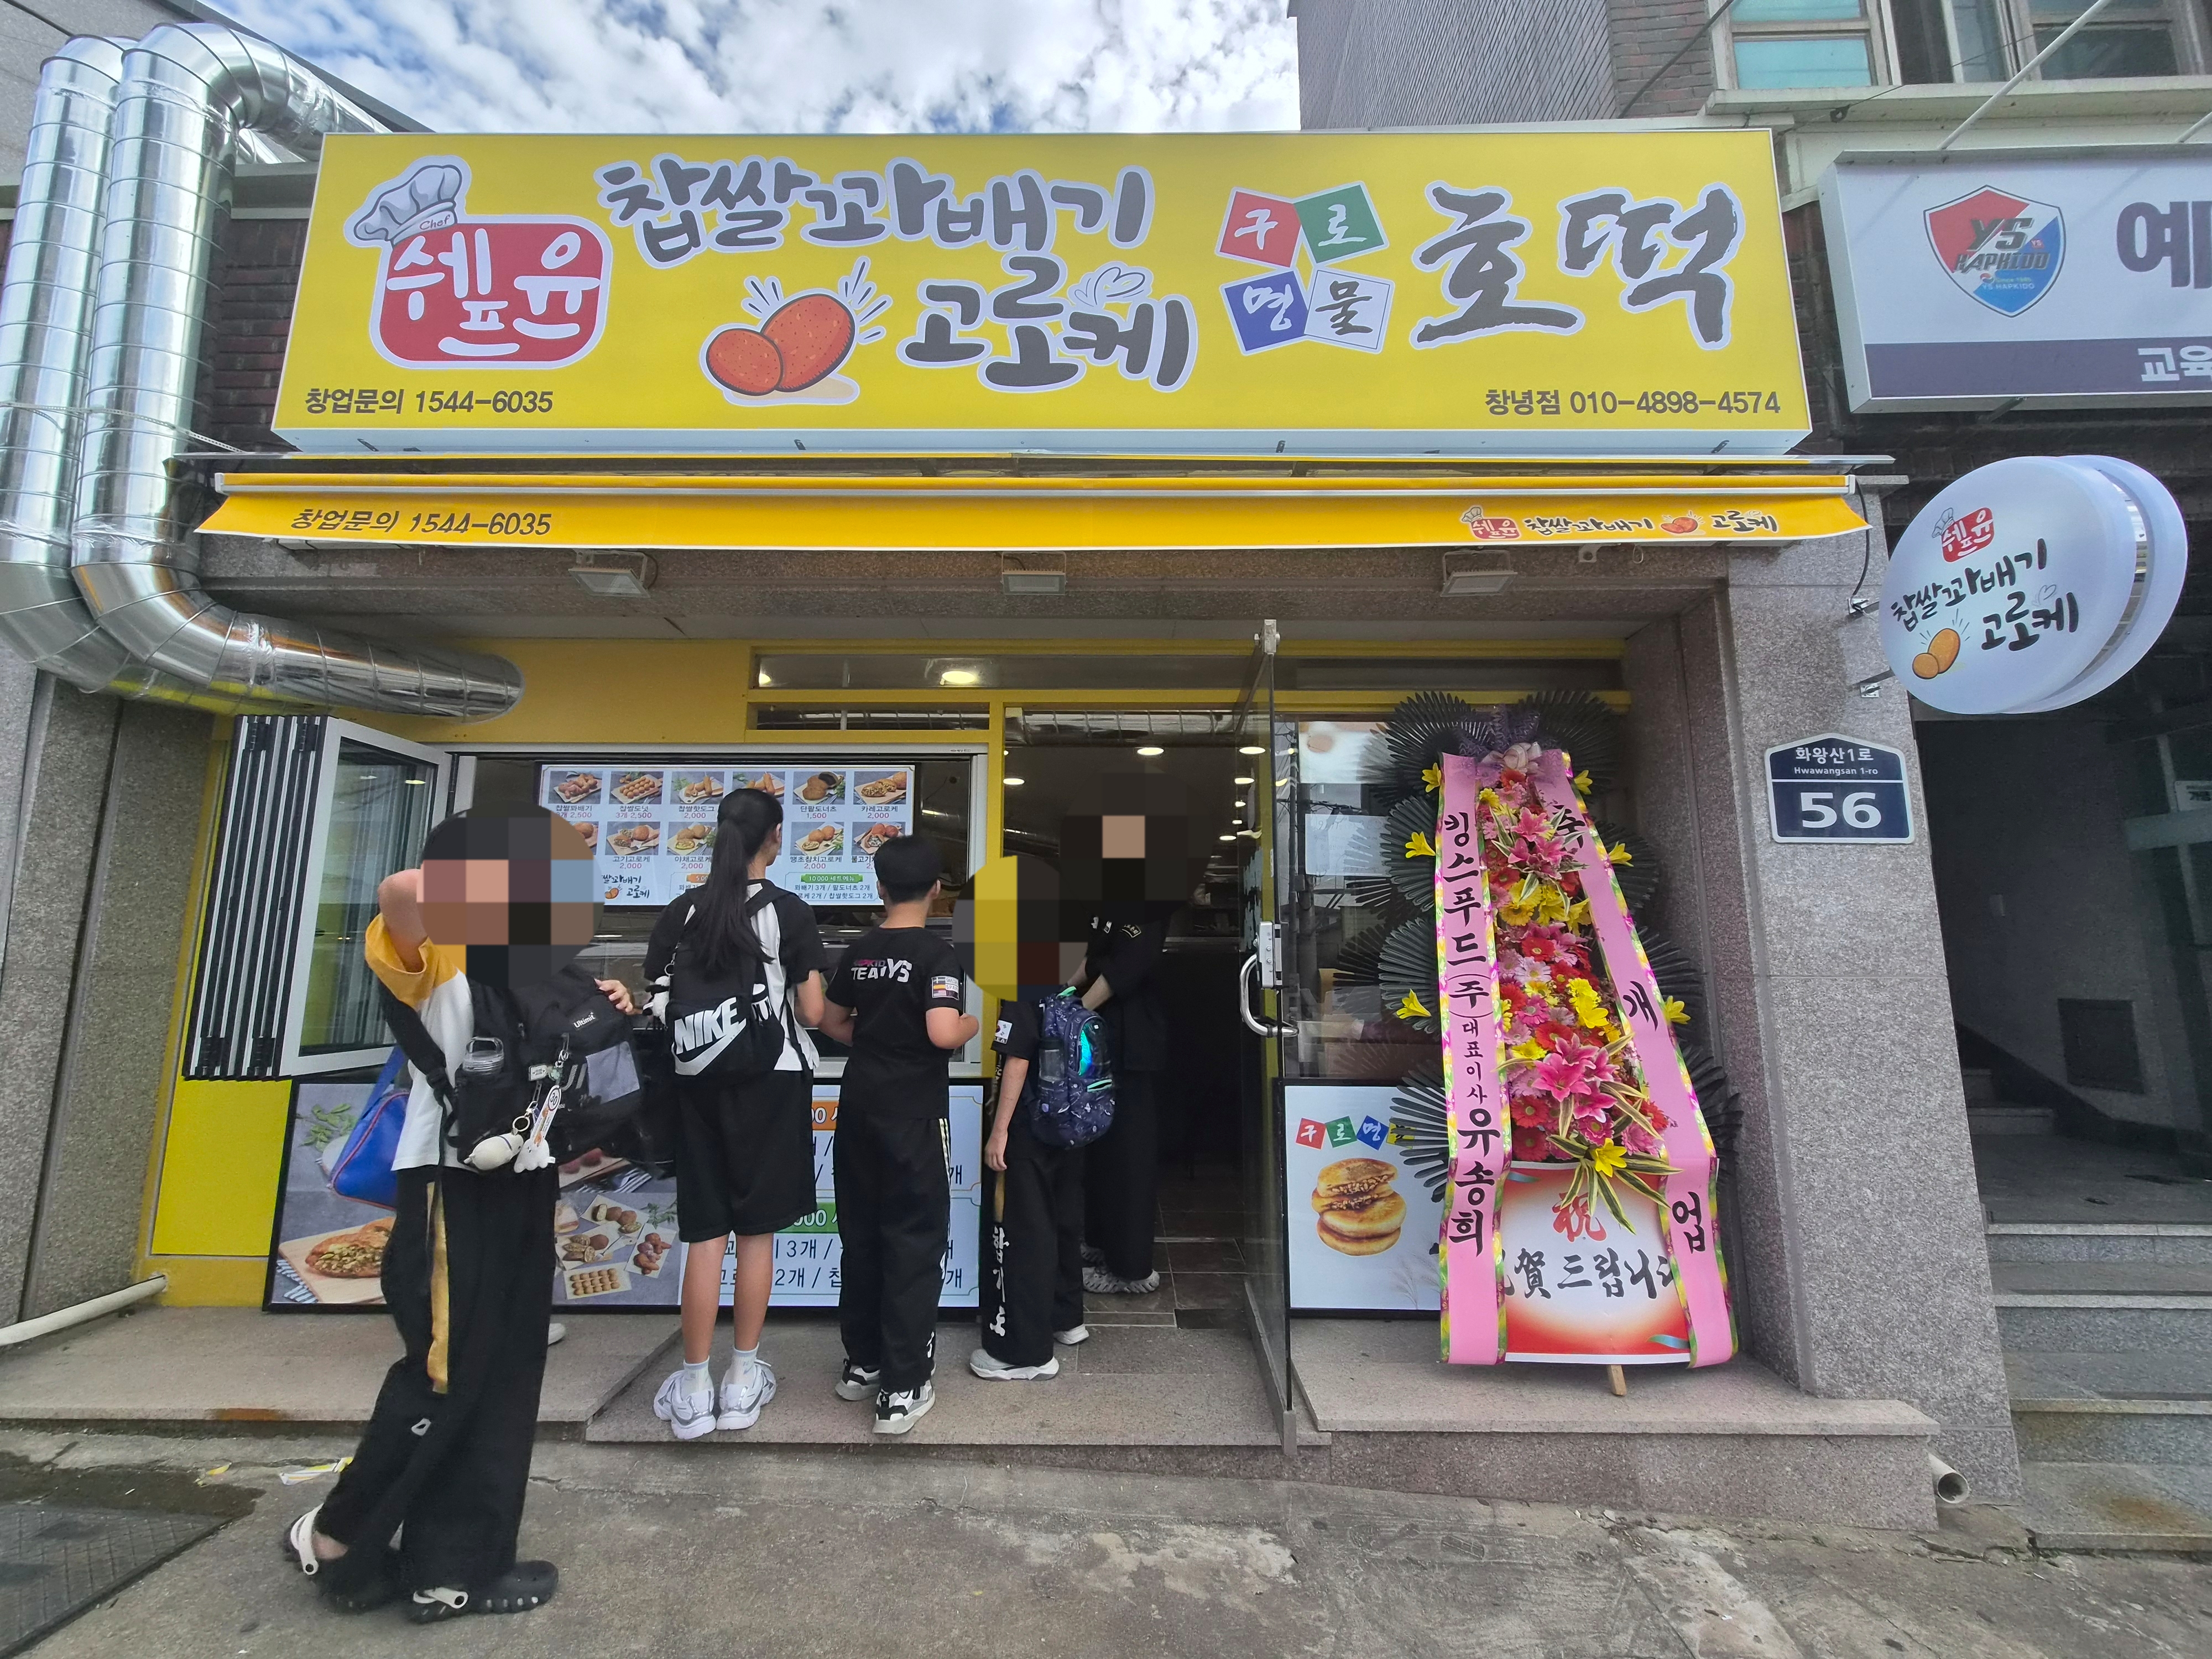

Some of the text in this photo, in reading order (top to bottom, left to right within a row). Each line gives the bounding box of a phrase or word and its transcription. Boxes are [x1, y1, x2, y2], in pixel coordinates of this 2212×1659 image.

[419, 213, 451, 230] Chef
[602, 159, 1147, 264] 찹쌀꽈배기
[1966, 217, 2035, 252] YS
[1416, 186, 1739, 343] 호떡
[904, 255, 1189, 387] 고로케
[305, 388, 554, 415] 창업문의 1544-6035
[1485, 388, 1781, 416] 창녕점 010-4898-4574
[291, 508, 552, 536] 창업문의 1544-6035
[1524, 517, 1653, 535] 찹쌀꽈배기
[1710, 510, 1778, 533] 고로케
[1891, 538, 2047, 633] 찹쌀꽈배기
[1981, 592, 2079, 652] 고로케
[1793, 766, 1879, 776] Hwawangsan 1-ro
[1795, 747, 1874, 765] 화왕산1로
[1800, 791, 1882, 829] 56
[601, 874, 641, 884] 쌀꽈배기
[627, 885, 650, 899] 고로케
[887, 958, 912, 983] YS
[674, 996, 741, 1055] NIKE
[1462, 1018, 1488, 1105] 대표이사
[1502, 1248, 1552, 1300] 賀
